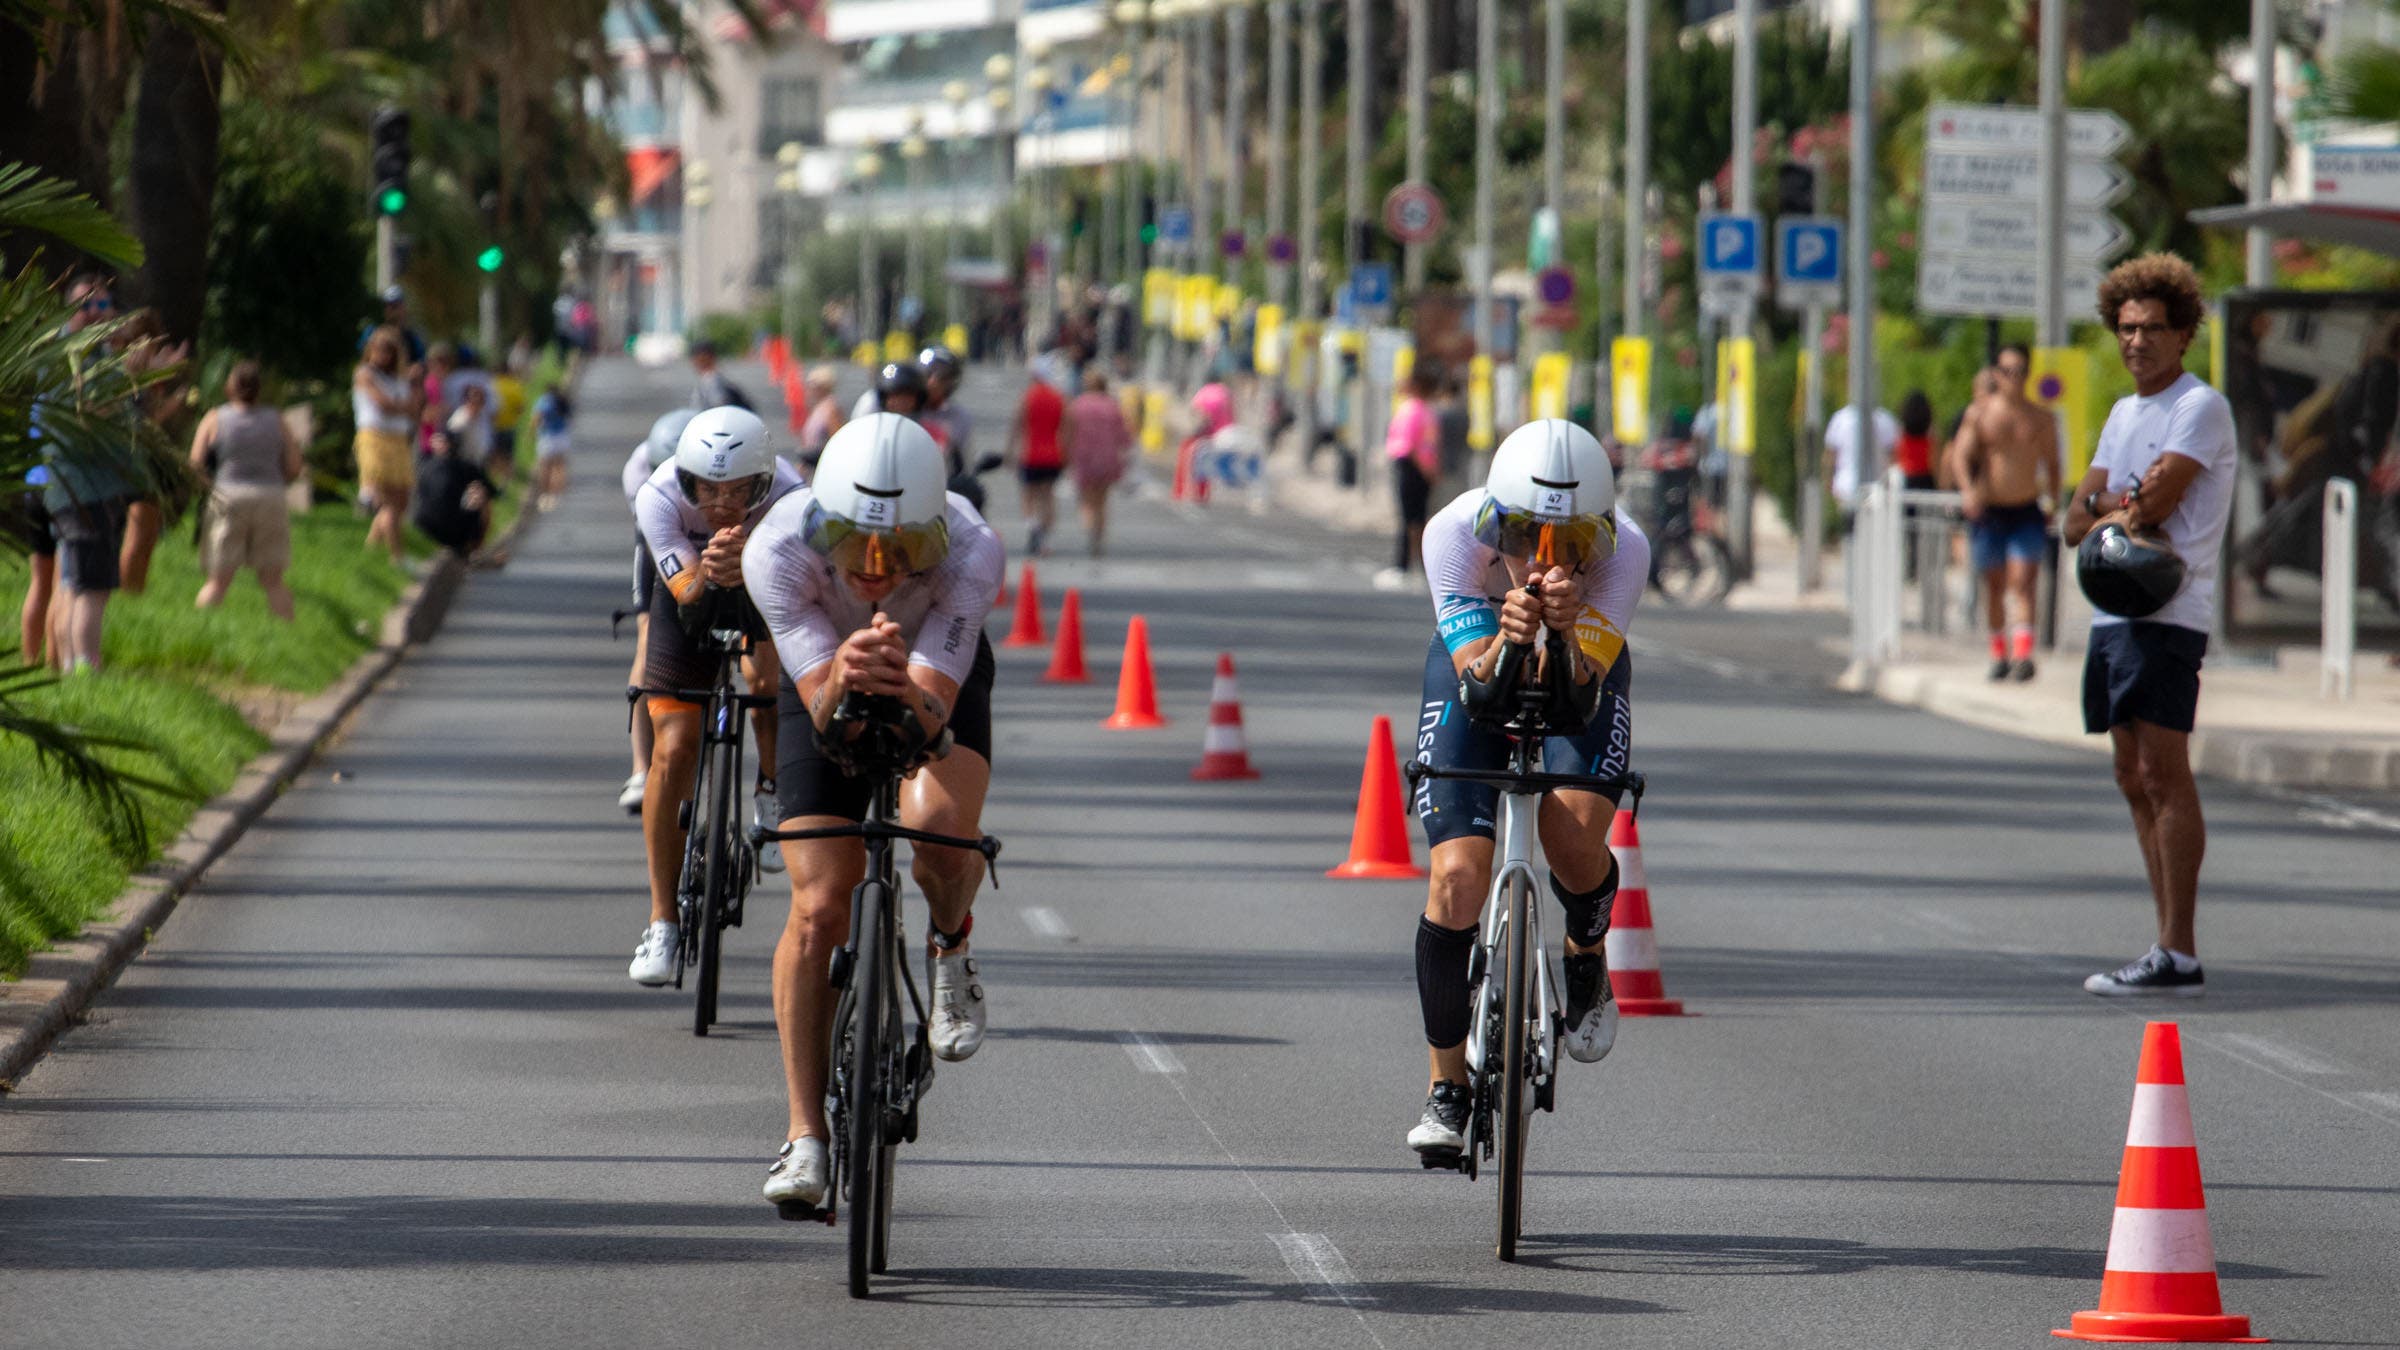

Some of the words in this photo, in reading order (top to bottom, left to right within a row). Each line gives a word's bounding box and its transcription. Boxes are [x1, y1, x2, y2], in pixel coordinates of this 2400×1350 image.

[1715, 226, 1744, 263] P
[1796, 232, 1827, 271] P
[869, 500, 885, 513] 23
[1547, 493, 1563, 504] 47
